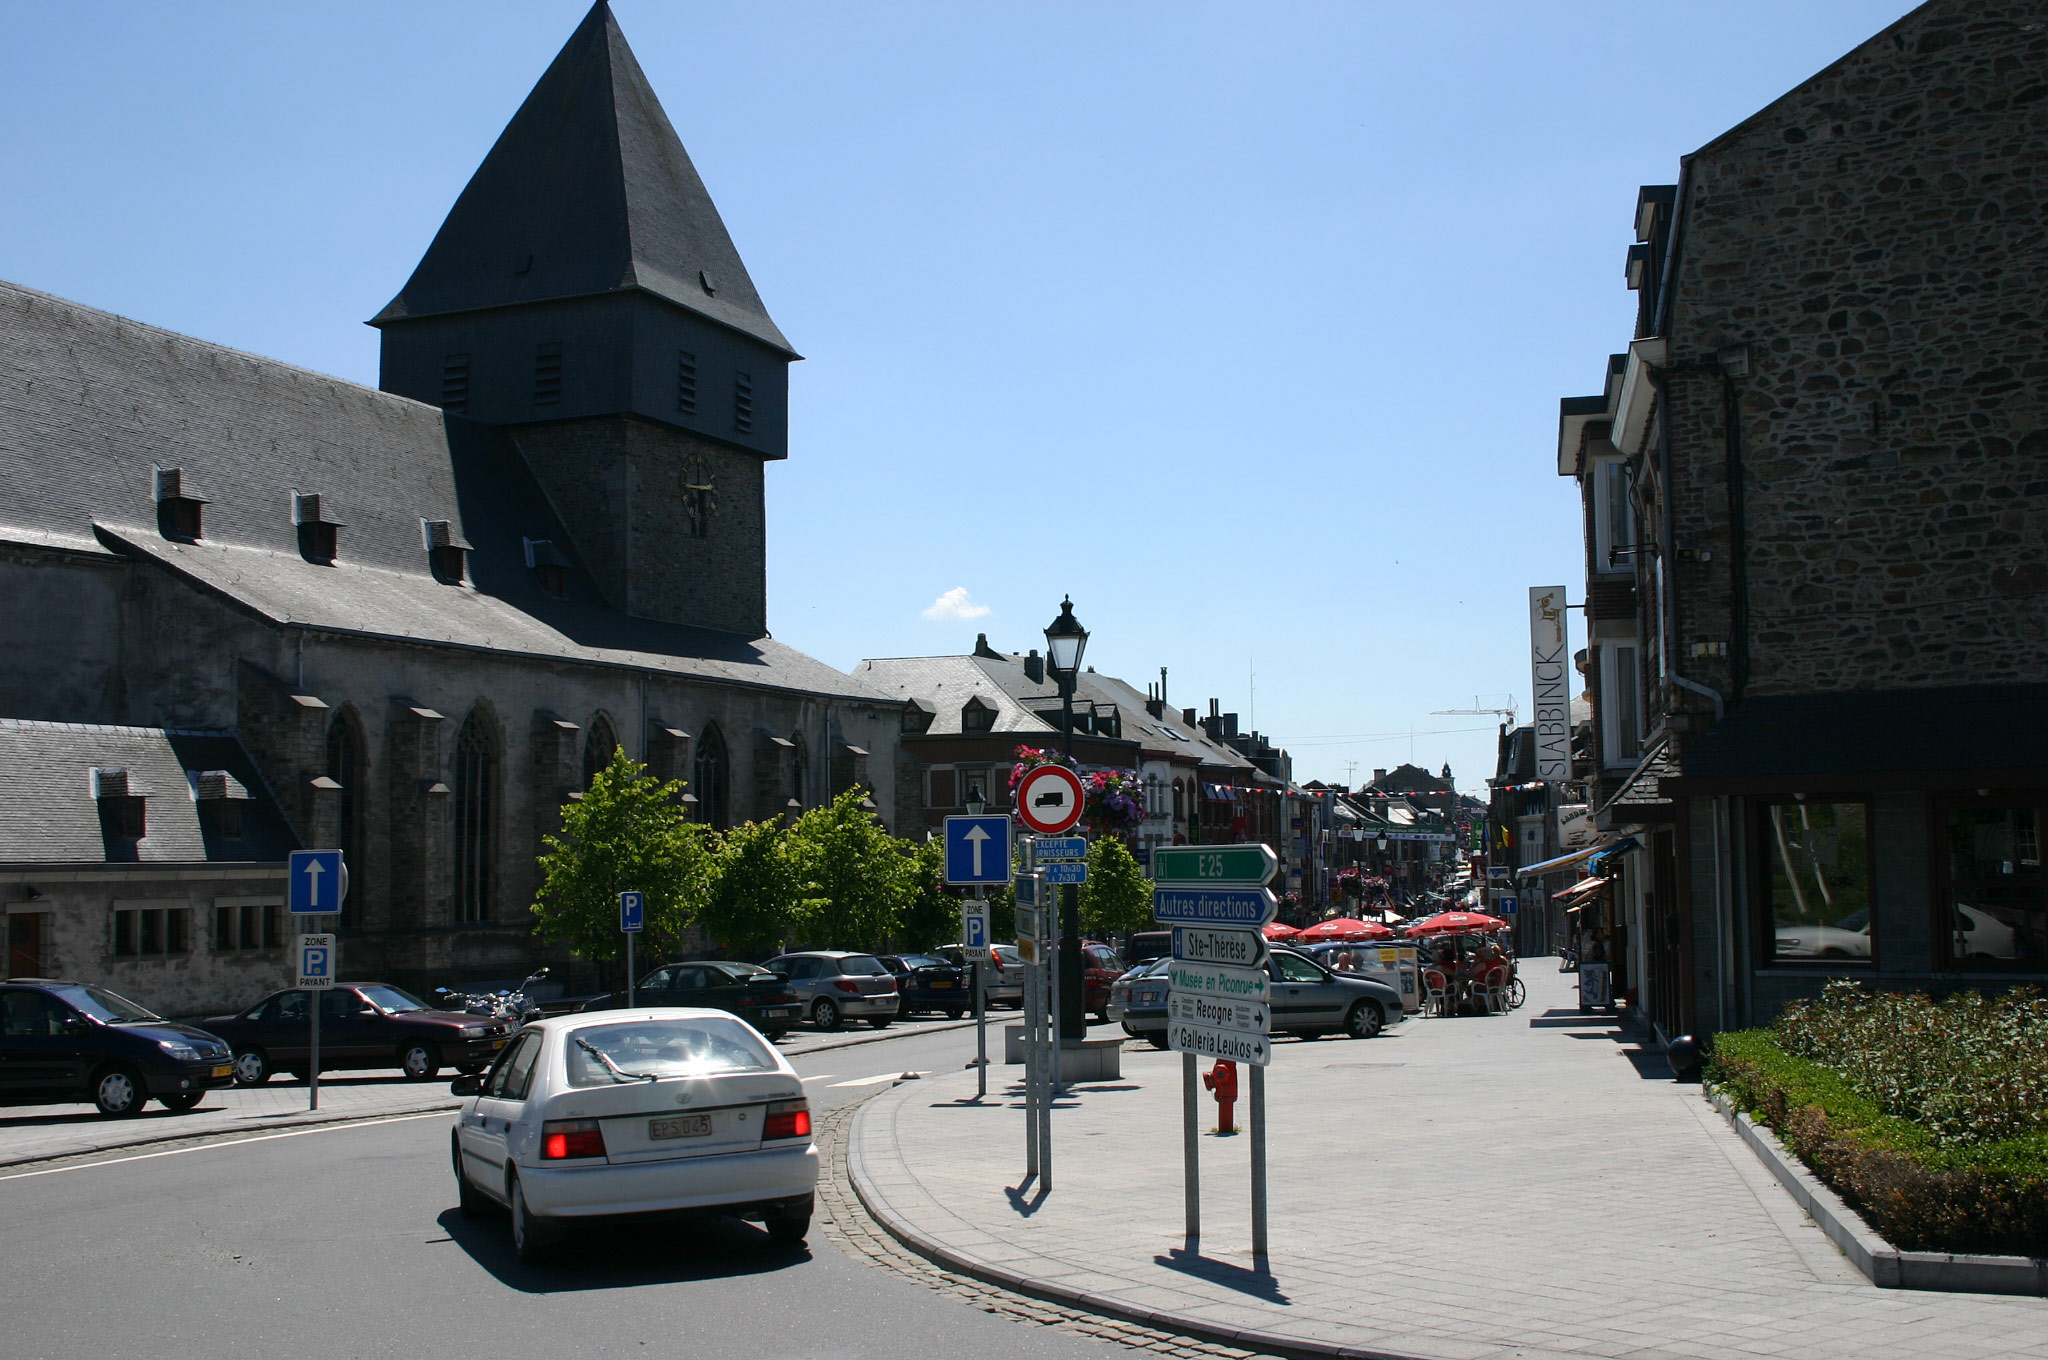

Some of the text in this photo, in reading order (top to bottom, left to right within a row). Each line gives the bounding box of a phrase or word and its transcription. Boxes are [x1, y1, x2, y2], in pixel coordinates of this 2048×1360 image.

[1535, 643, 1567, 775] SLABBINCK
[1560, 809, 1587, 825] SANDW
[1199, 854, 1224, 877] E 25
[626, 895, 638, 916] P
[966, 905, 983, 914] ZONE
[1159, 893, 1256, 919] Autres directions
[304, 937, 328, 946] ZONE
[969, 919, 982, 945] P
[965, 949, 987, 958] PAYANT
[1174, 930, 1246, 960] H Ste-Thérèse
[306, 950, 324, 974] P
[299, 977, 331, 986] PAYANT
[1179, 969, 1254, 995] Musée en Piconrue
[1196, 999, 1232, 1024] Recogne
[1180, 1027, 1251, 1058] Galleria Leukos
